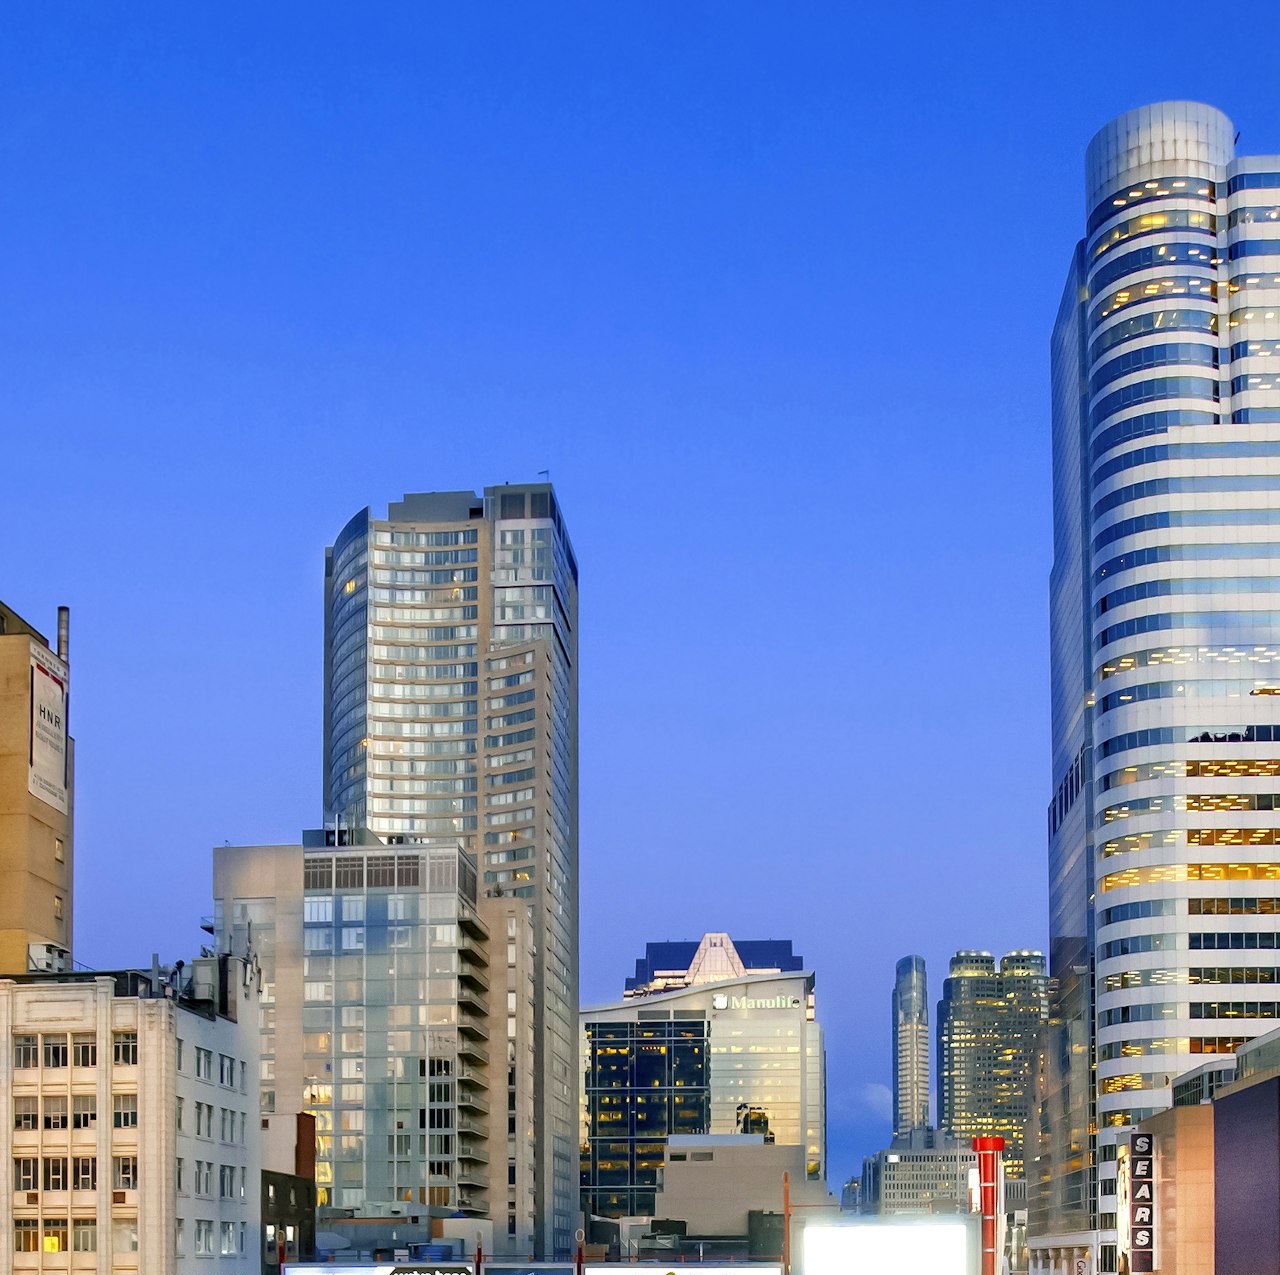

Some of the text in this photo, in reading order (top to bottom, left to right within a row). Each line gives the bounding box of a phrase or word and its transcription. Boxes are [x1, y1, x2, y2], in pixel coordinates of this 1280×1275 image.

[38, 703, 61, 730] HNR
[731, 995, 800, 1009] Manulife
[1135, 1136, 1151, 1246] SEARS
